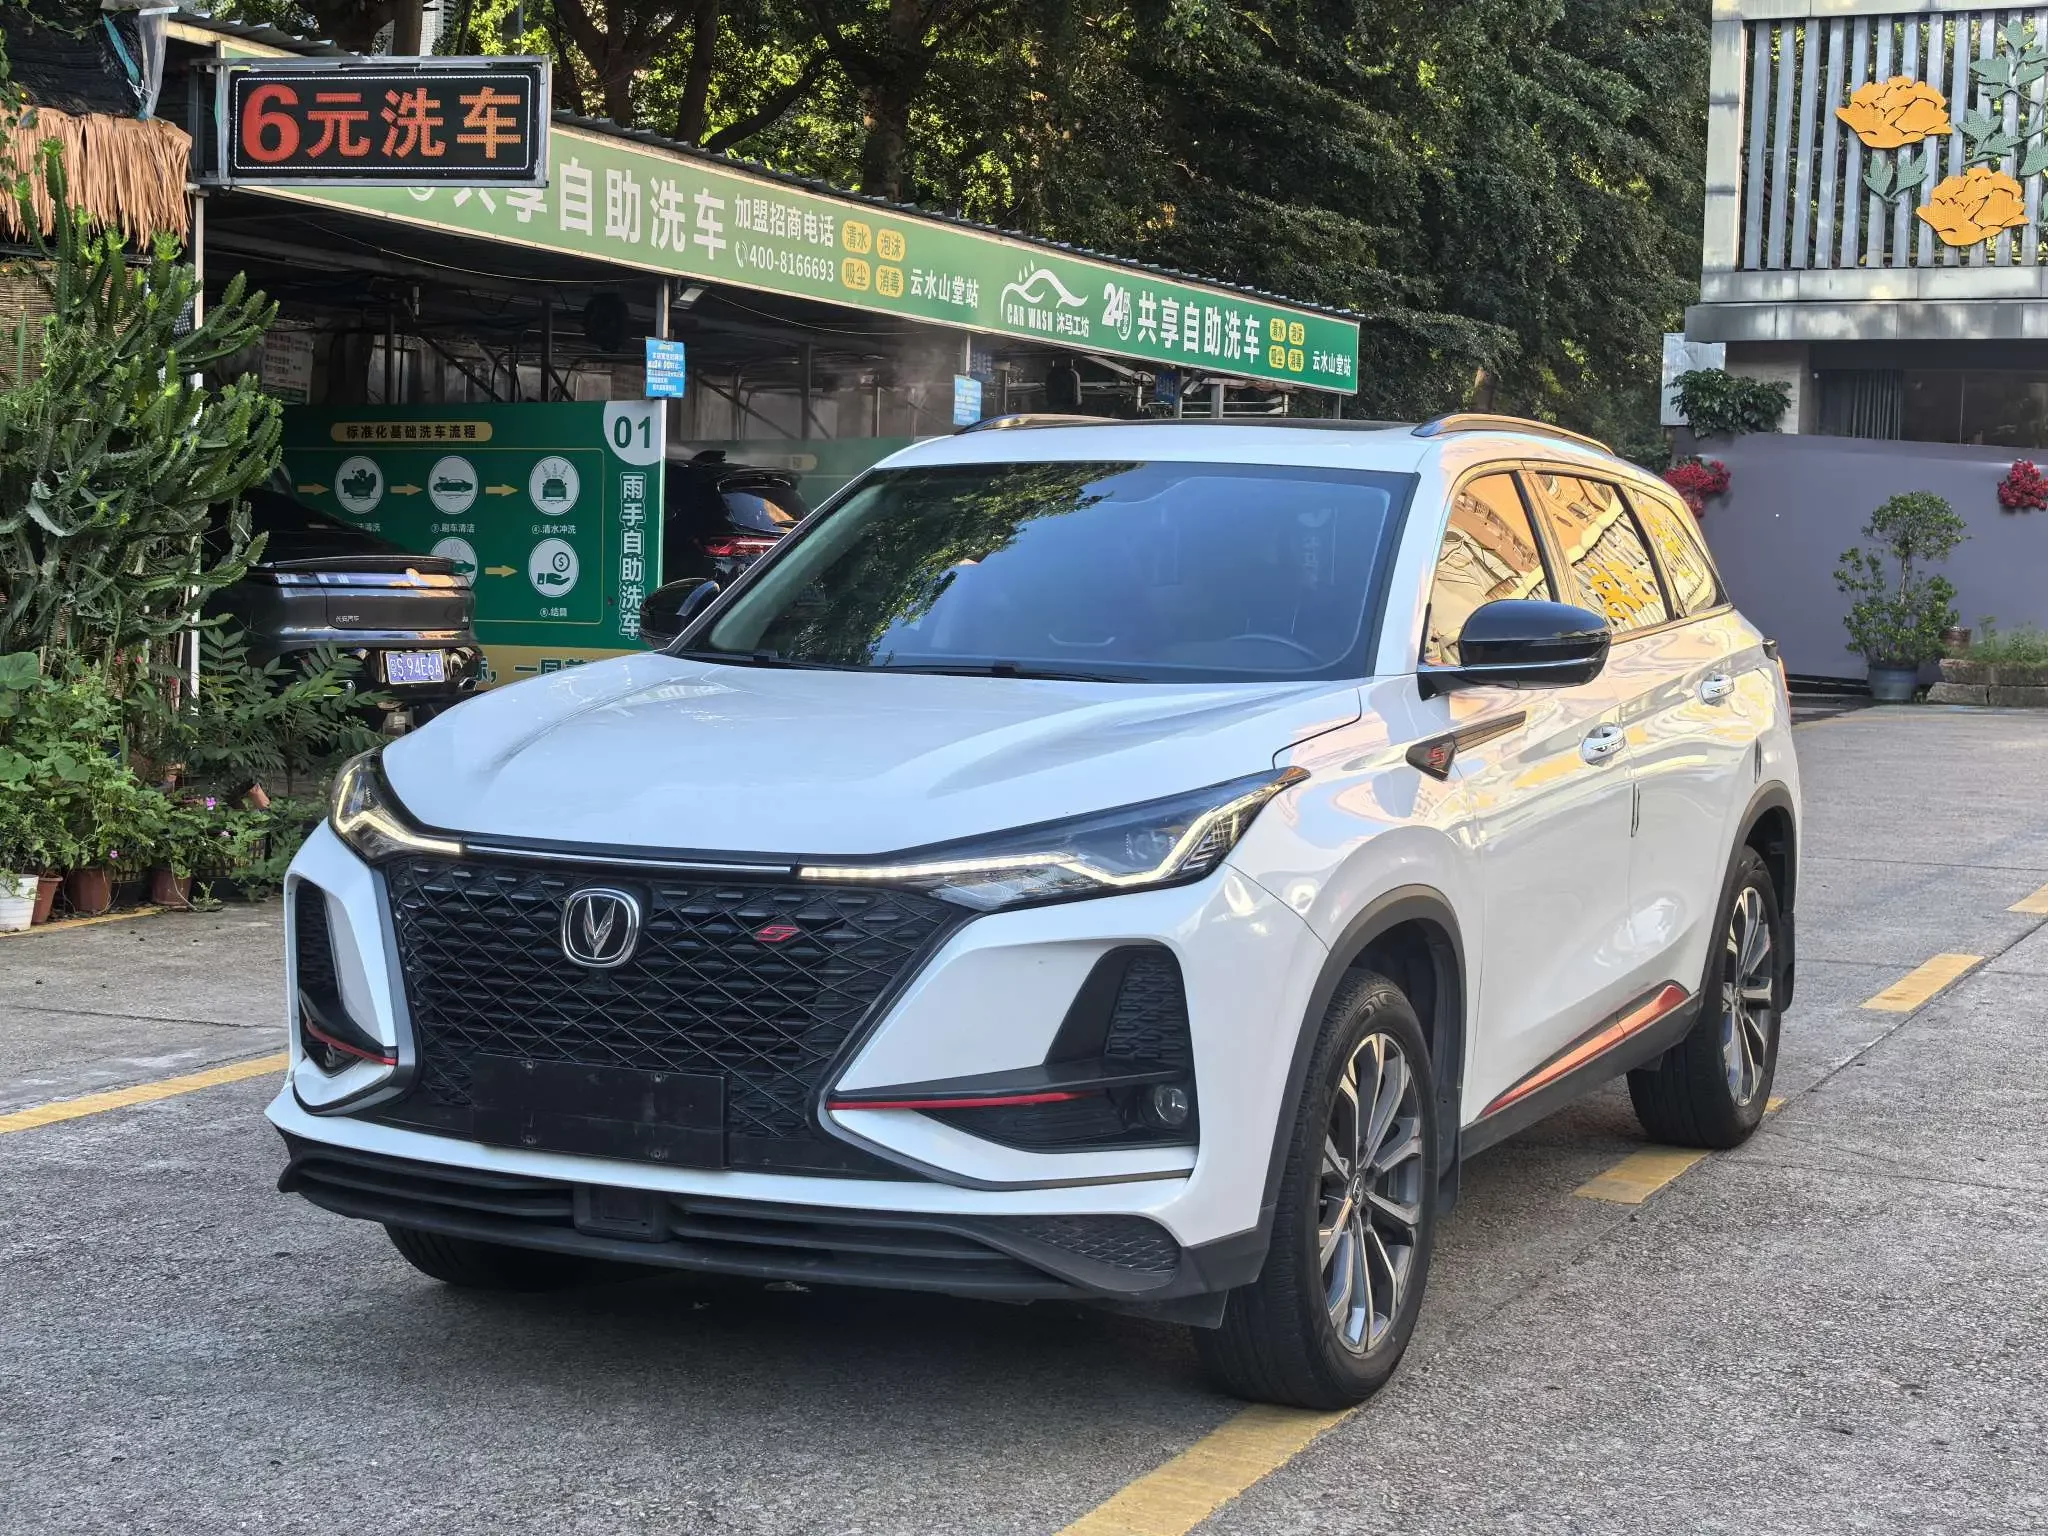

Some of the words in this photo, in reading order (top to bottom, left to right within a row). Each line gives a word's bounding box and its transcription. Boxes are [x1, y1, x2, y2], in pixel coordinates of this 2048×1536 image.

[242, 84, 521, 163] 6元洗车
[454, 158, 727, 260] 自助洗车
[735, 193, 834, 248] 加盟招商电话
[847, 224, 868, 250] 清水
[881, 232, 901, 257] 泡沫
[749, 244, 834, 283] 400-8166693
[845, 262, 867, 287] 吸尘
[880, 268, 900, 293] 消毒
[910, 268, 979, 309] 云水山堂站
[1007, 303, 1025, 327] CAR
[1056, 311, 1090, 338] 沐马工坊
[1138, 290, 1260, 364] 共享自助洗车
[1312, 350, 1352, 377] 云水山堂站
[346, 424, 477, 440] 标准化基础洗车流程
[613, 416, 651, 450] 01
